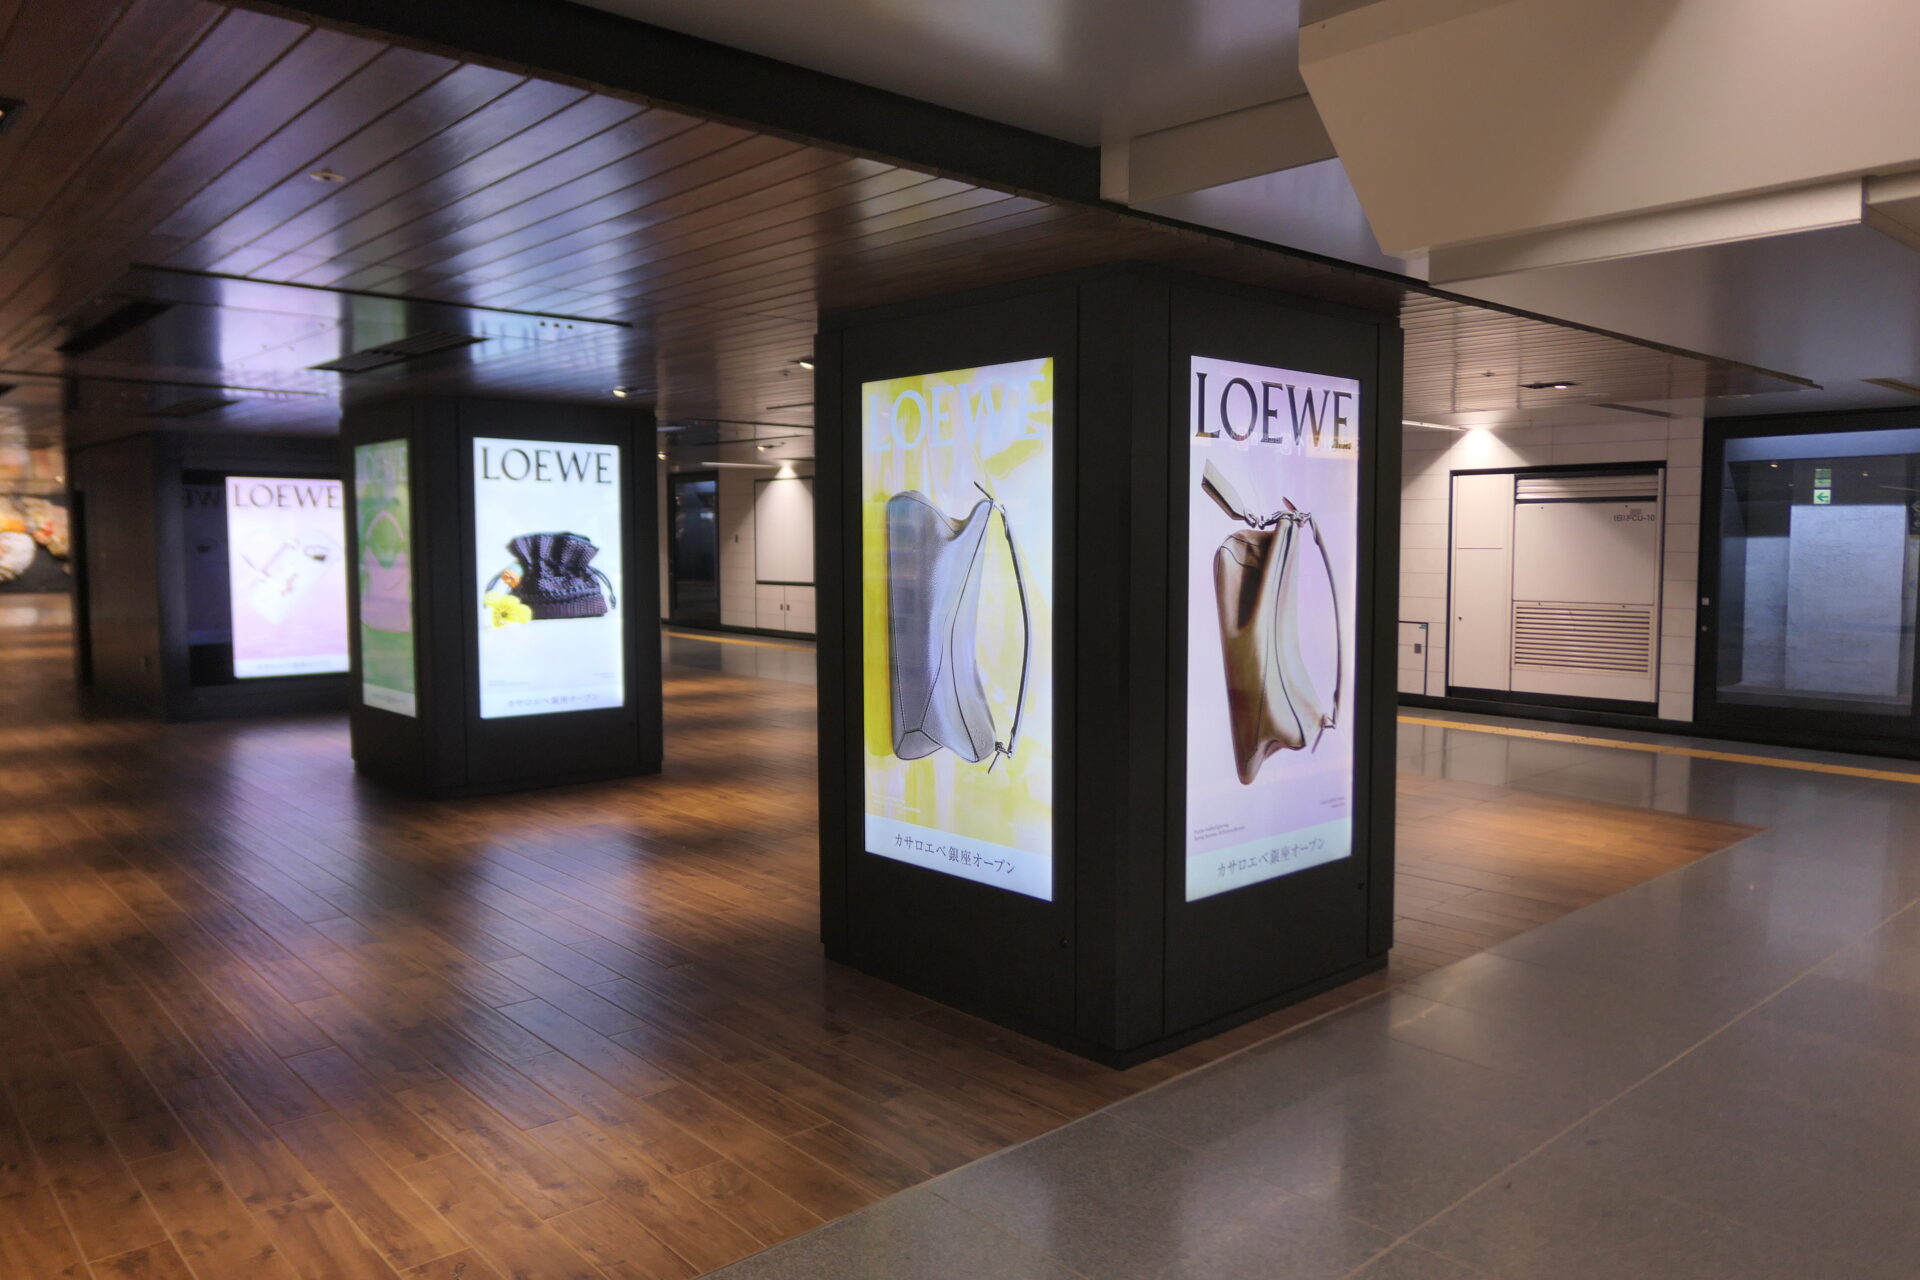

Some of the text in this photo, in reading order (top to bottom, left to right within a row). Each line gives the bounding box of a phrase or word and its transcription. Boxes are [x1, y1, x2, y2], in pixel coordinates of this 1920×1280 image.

[867, 373, 1045, 453] LOEWE
[1195, 371, 1353, 450] LOEWE
[481, 446, 612, 484] LOEWE
[233, 483, 341, 508] LOEWE
[895, 833, 1016, 875] カサロエベ銀座オープン
